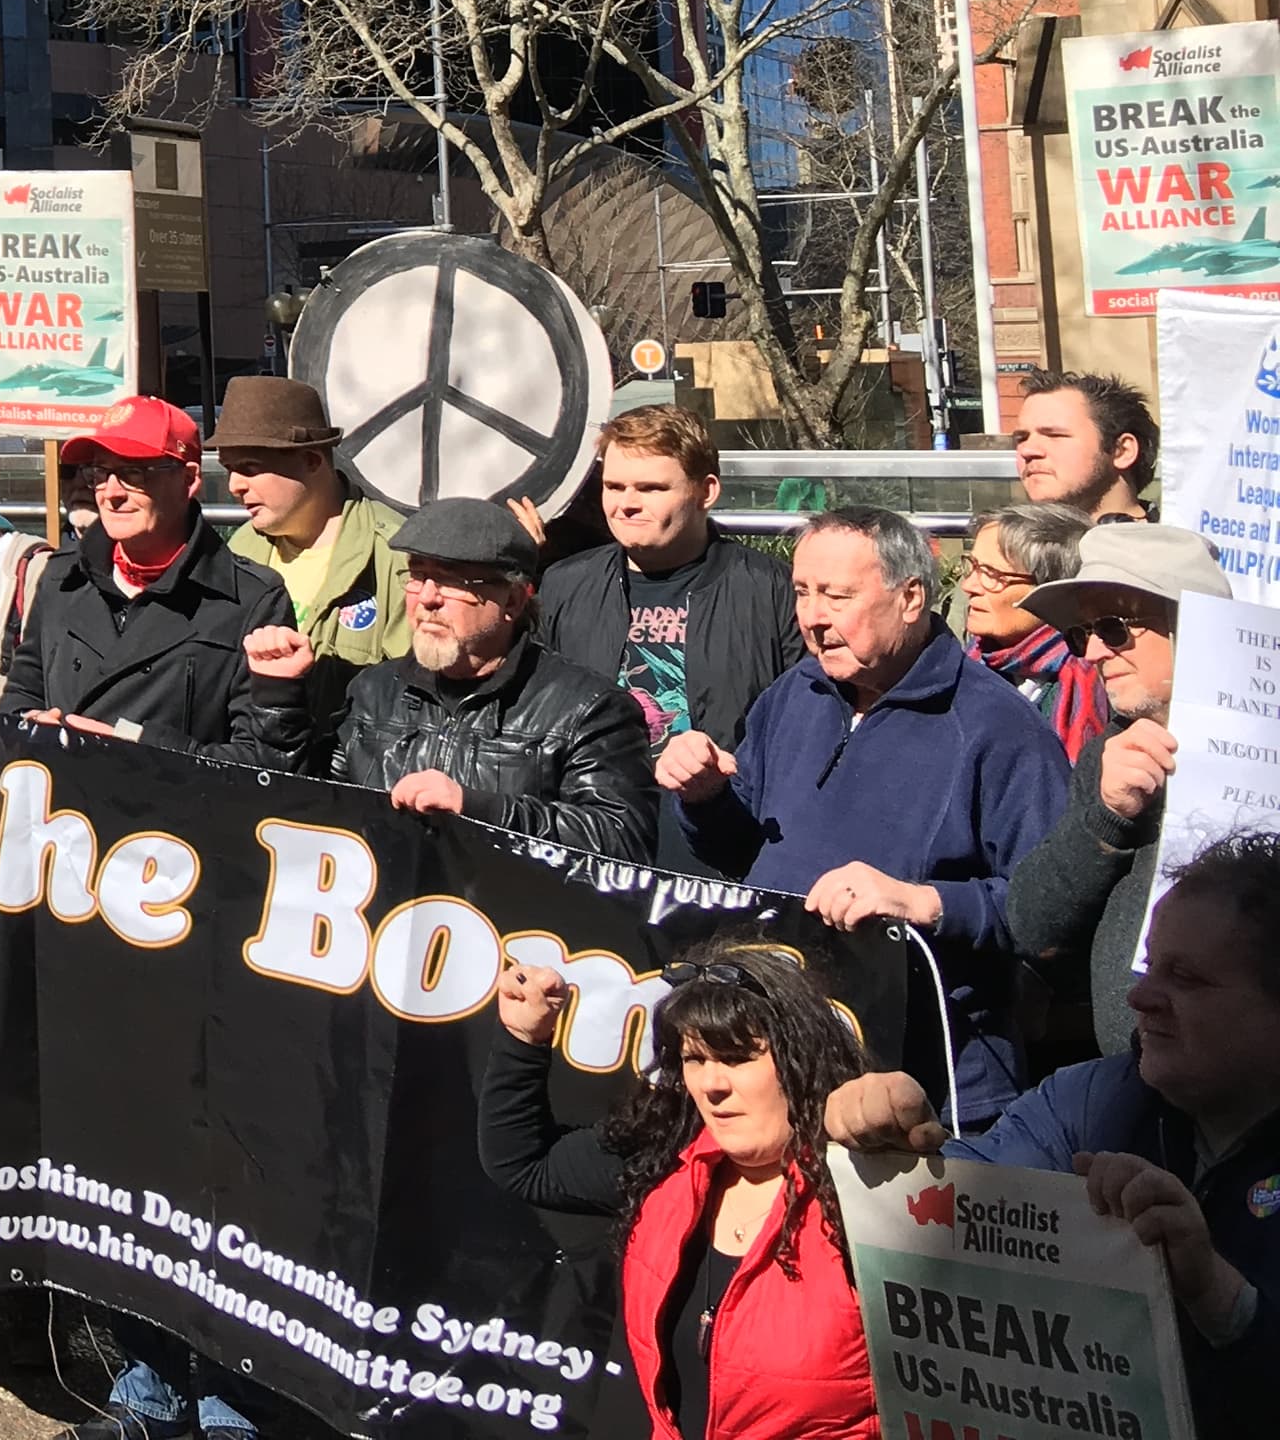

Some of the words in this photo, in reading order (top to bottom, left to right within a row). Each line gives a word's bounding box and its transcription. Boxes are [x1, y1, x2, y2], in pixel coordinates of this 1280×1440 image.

[1153, 45, 1222, 63] Socialist
[1154, 60, 1222, 78] Alliance
[1093, 96, 1225, 132] BREAK
[1230, 104, 1261, 120] the
[1095, 129, 1264, 158] US-Australia
[30, 187, 83, 201] Socialist
[1096, 162, 1234, 205] WAR
[30, 199, 83, 213] Alliance
[1101, 206, 1236, 231] ALLIANCE
[86, 244, 109, 257] the
[1200, 510, 1246, 538] Peace
[1256, 655, 1272, 672] IS
[1249, 676, 1276, 696] NO
[1221, 785, 1280, 810] PLEAS
[243, 817, 863, 1088] Bom
[956, 1193, 1059, 1234] Socialist
[963, 1222, 1061, 1264] Alliance
[141, 1189, 213, 1254] Day
[217, 1223, 401, 1334] Committee
[411, 1303, 596, 1382] Sydney
[883, 1280, 1079, 1374] BREAK
[1082, 1341, 1131, 1377] the
[893, 1350, 1141, 1440] US-Australia
